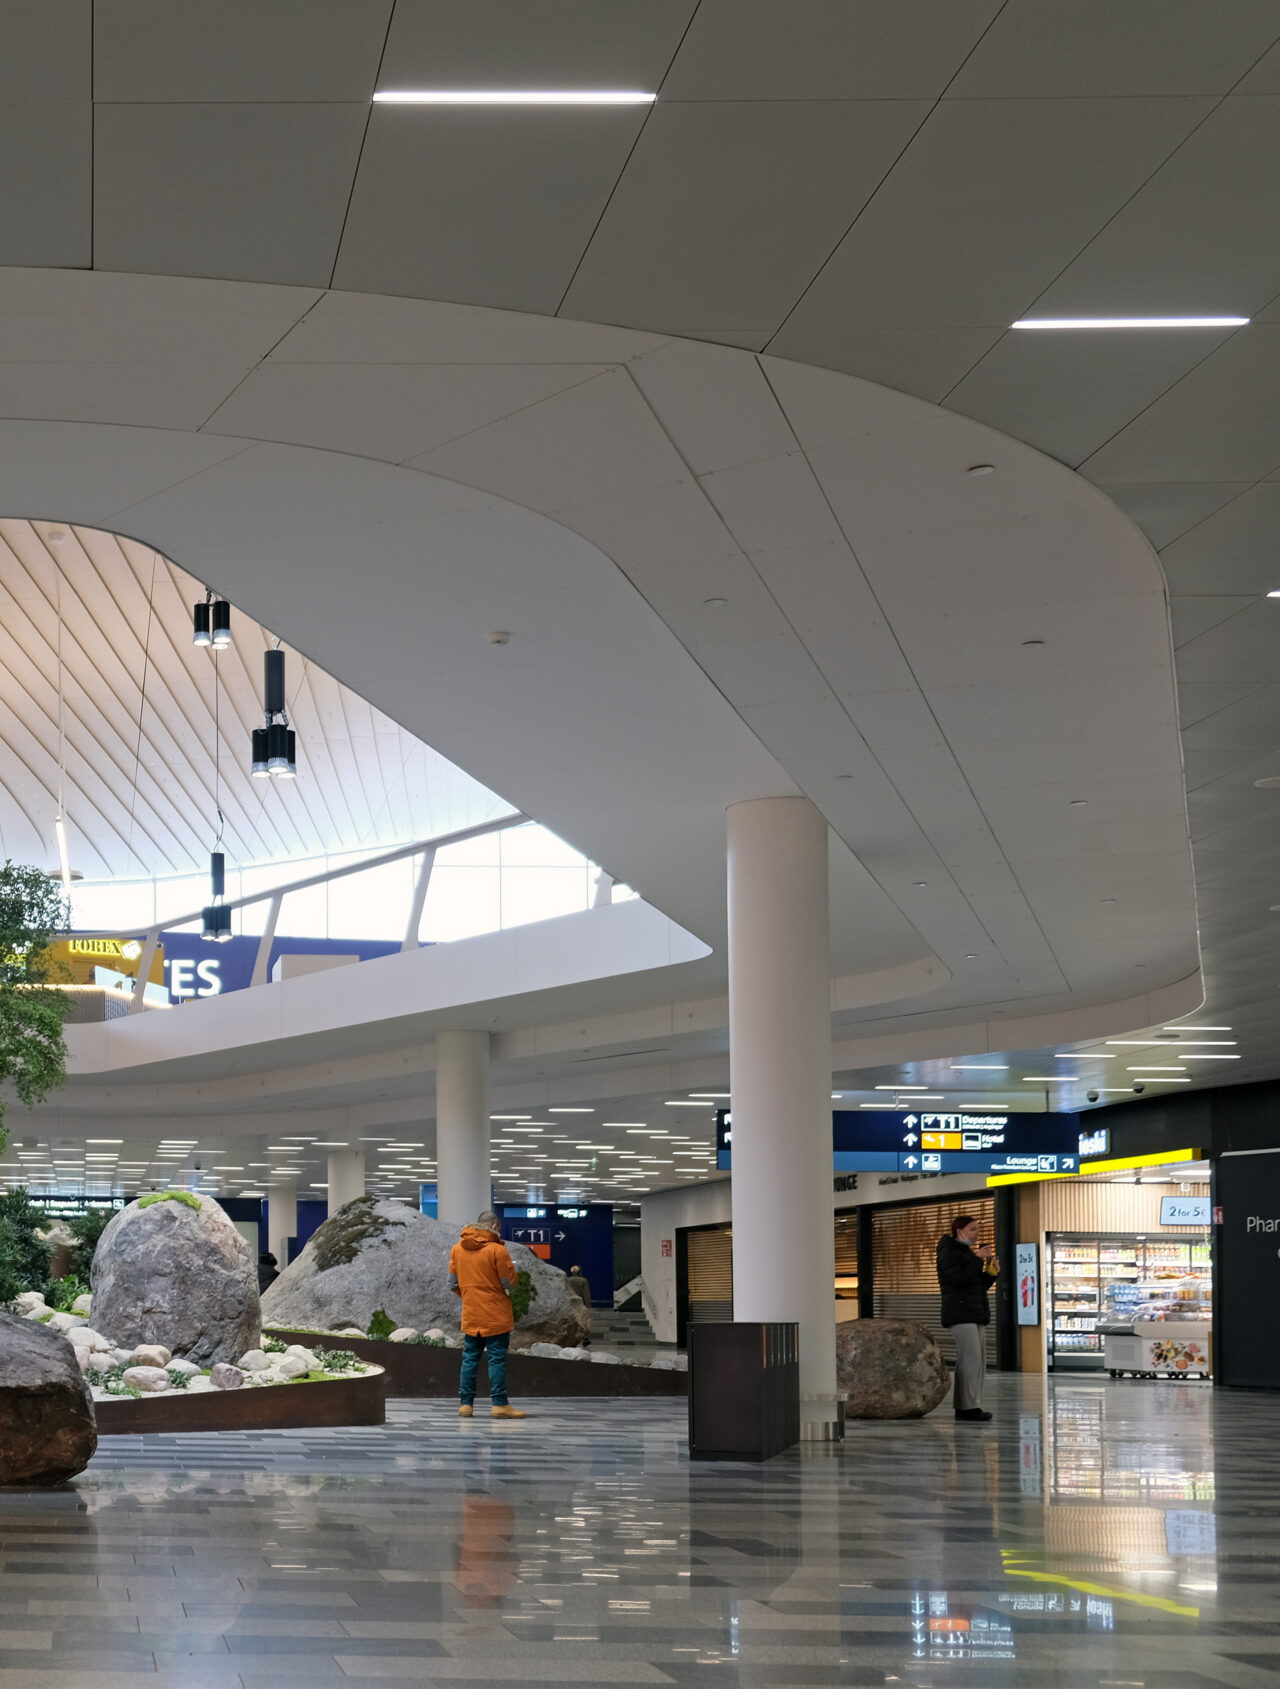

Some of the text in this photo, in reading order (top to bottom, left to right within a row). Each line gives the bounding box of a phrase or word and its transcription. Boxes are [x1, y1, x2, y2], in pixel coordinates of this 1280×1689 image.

[70, 938, 121, 955] FOREX
[164, 959, 222, 997] ES
[936, 1116, 956, 1129] T1
[962, 1115, 1008, 1126] Departures
[982, 1134, 1005, 1144] Hotel
[1006, 1156, 1038, 1167] Lounge
[1169, 1206, 1176, 1217] 2
[1177, 1207, 1190, 1217] for
[527, 1229, 544, 1242] T1
